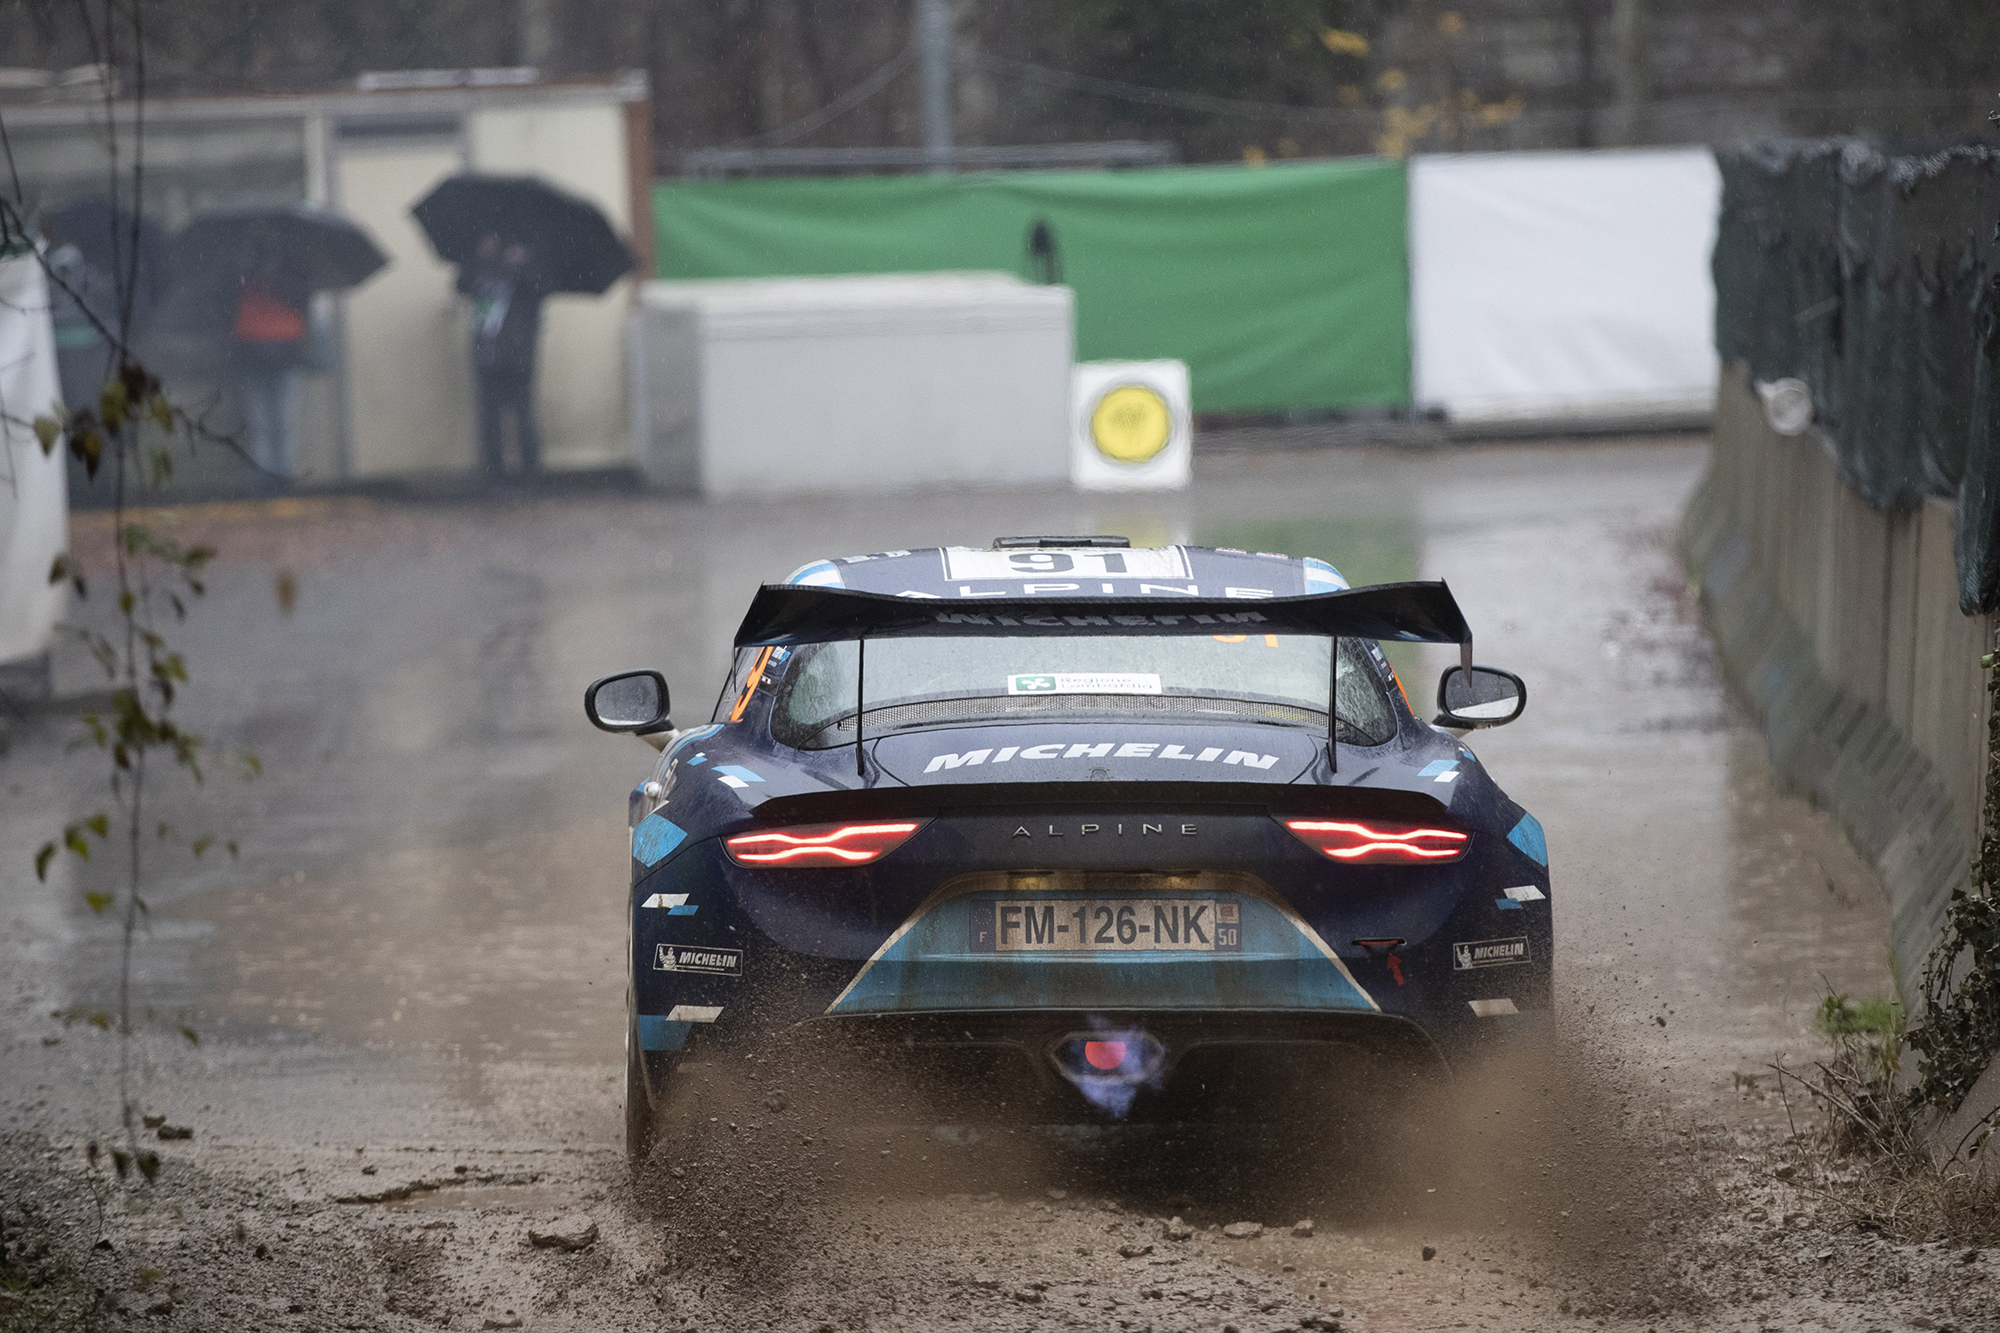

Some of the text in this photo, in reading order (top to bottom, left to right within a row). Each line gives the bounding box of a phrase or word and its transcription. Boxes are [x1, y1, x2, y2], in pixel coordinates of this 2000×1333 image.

[1008, 553, 1127, 573] 91
[896, 583, 1274, 599] ALPINE
[1060, 682, 1153, 690] Lombardia
[923, 742, 1280, 773] MICHELIN
[1012, 823, 1198, 838] ALPINE
[979, 905, 1237, 946] F FM-126-NK 50
[1474, 943, 1524, 959] MICHELIN
[679, 952, 737, 967] MICHELIN
